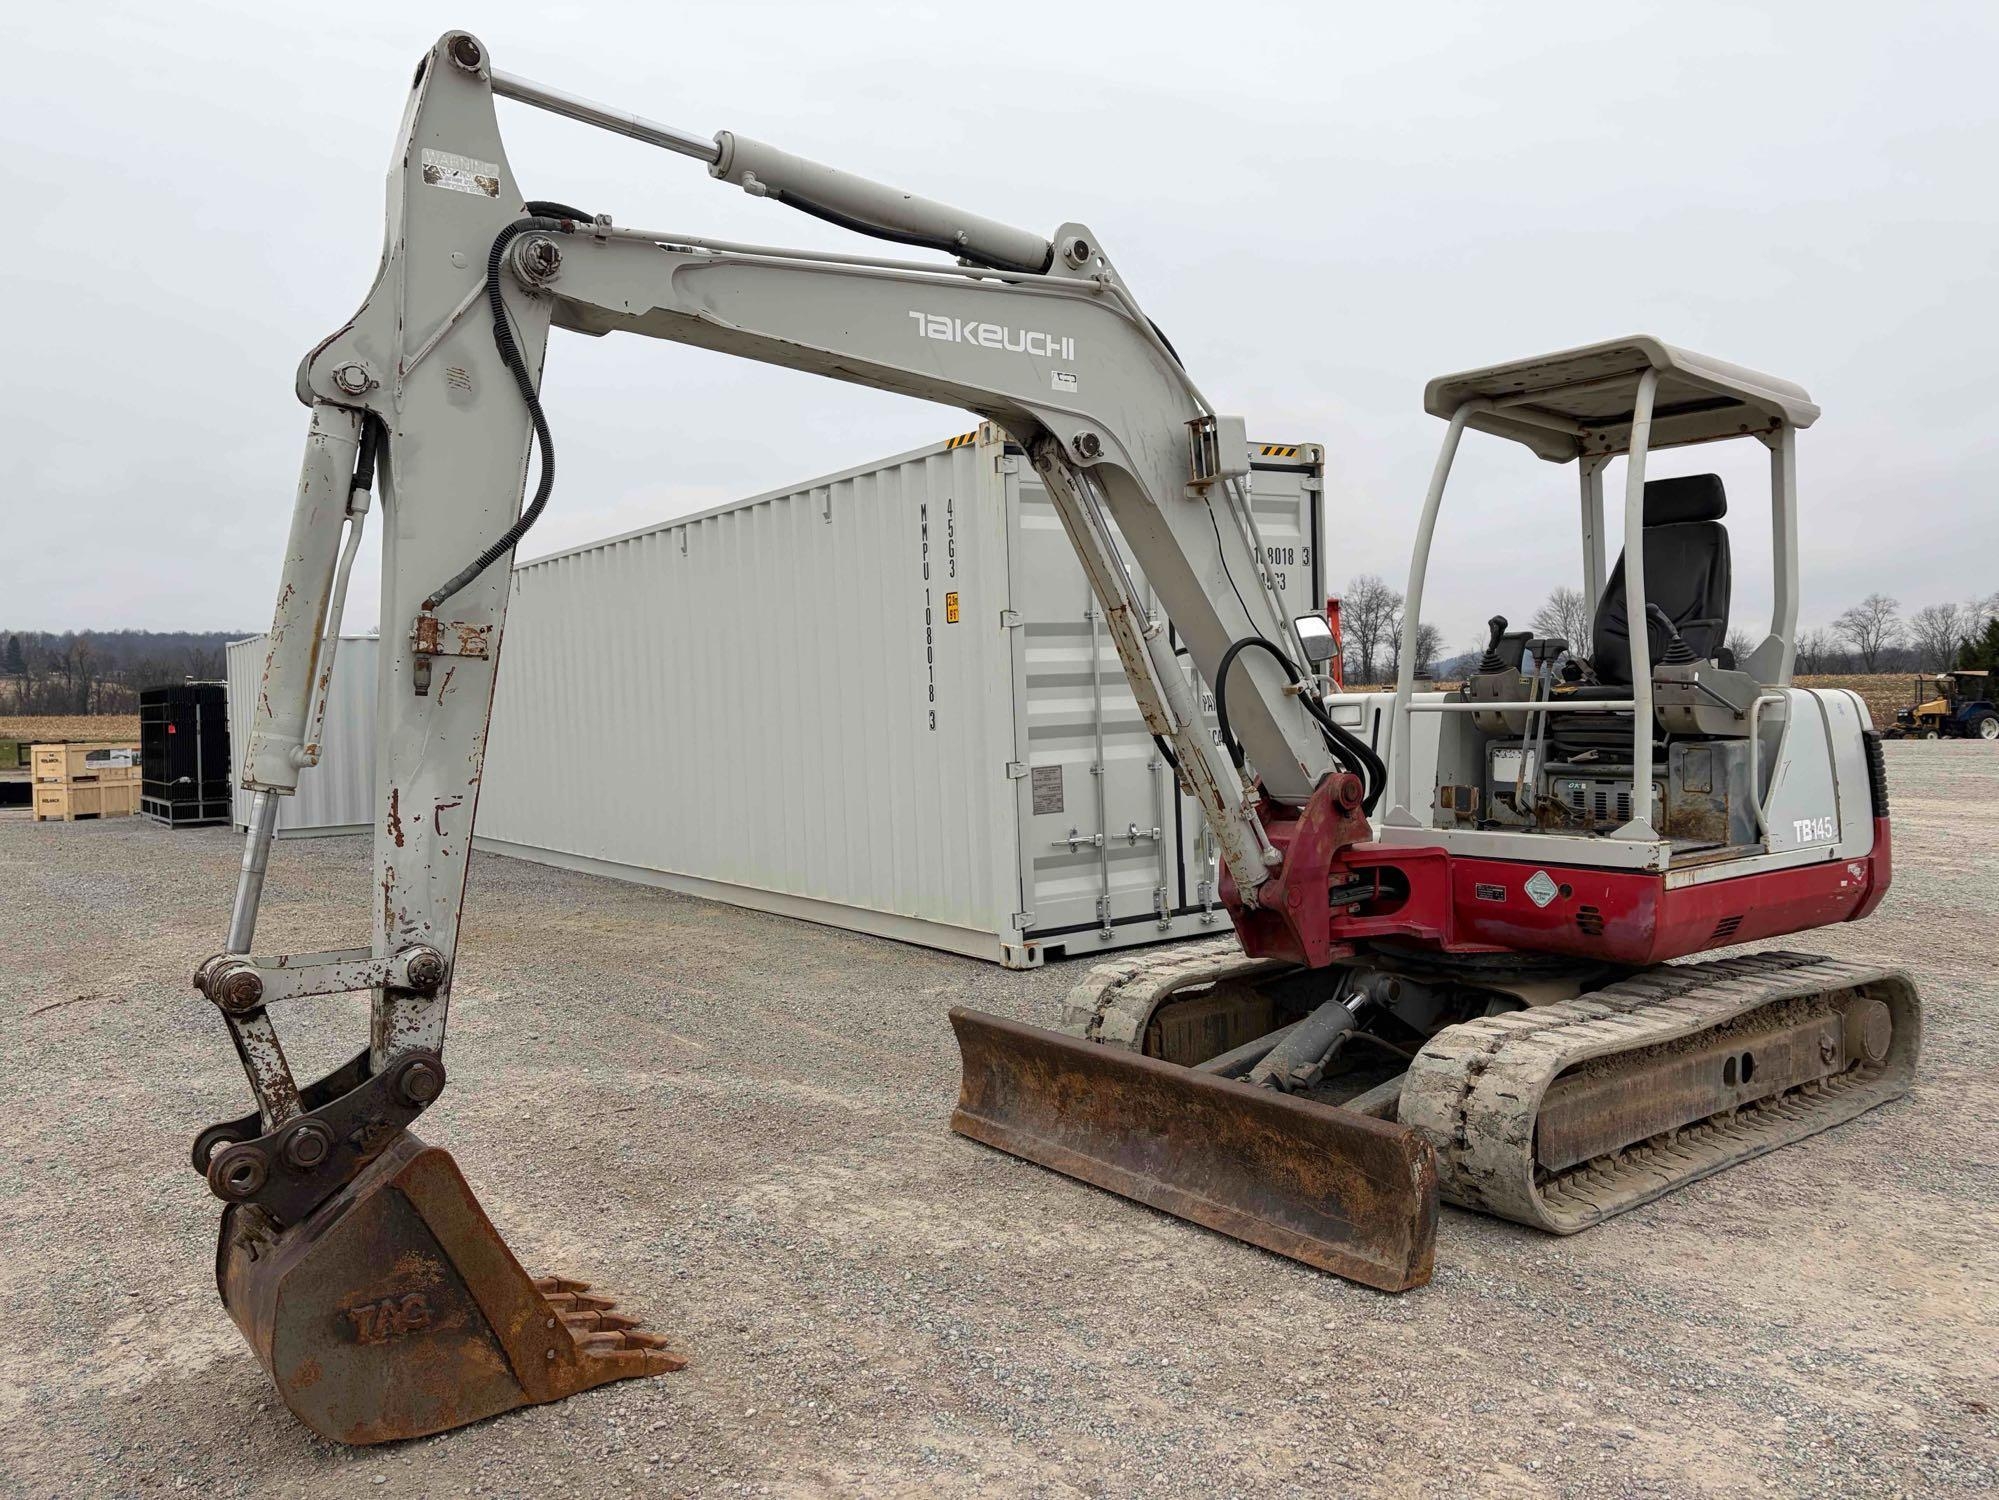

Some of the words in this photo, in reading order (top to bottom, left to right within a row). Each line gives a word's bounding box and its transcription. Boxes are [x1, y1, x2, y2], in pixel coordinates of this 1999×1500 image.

[1254, 547, 1294, 565] 18018
[1302, 547, 1310, 566] 3
[1793, 816, 1833, 843] TB145
